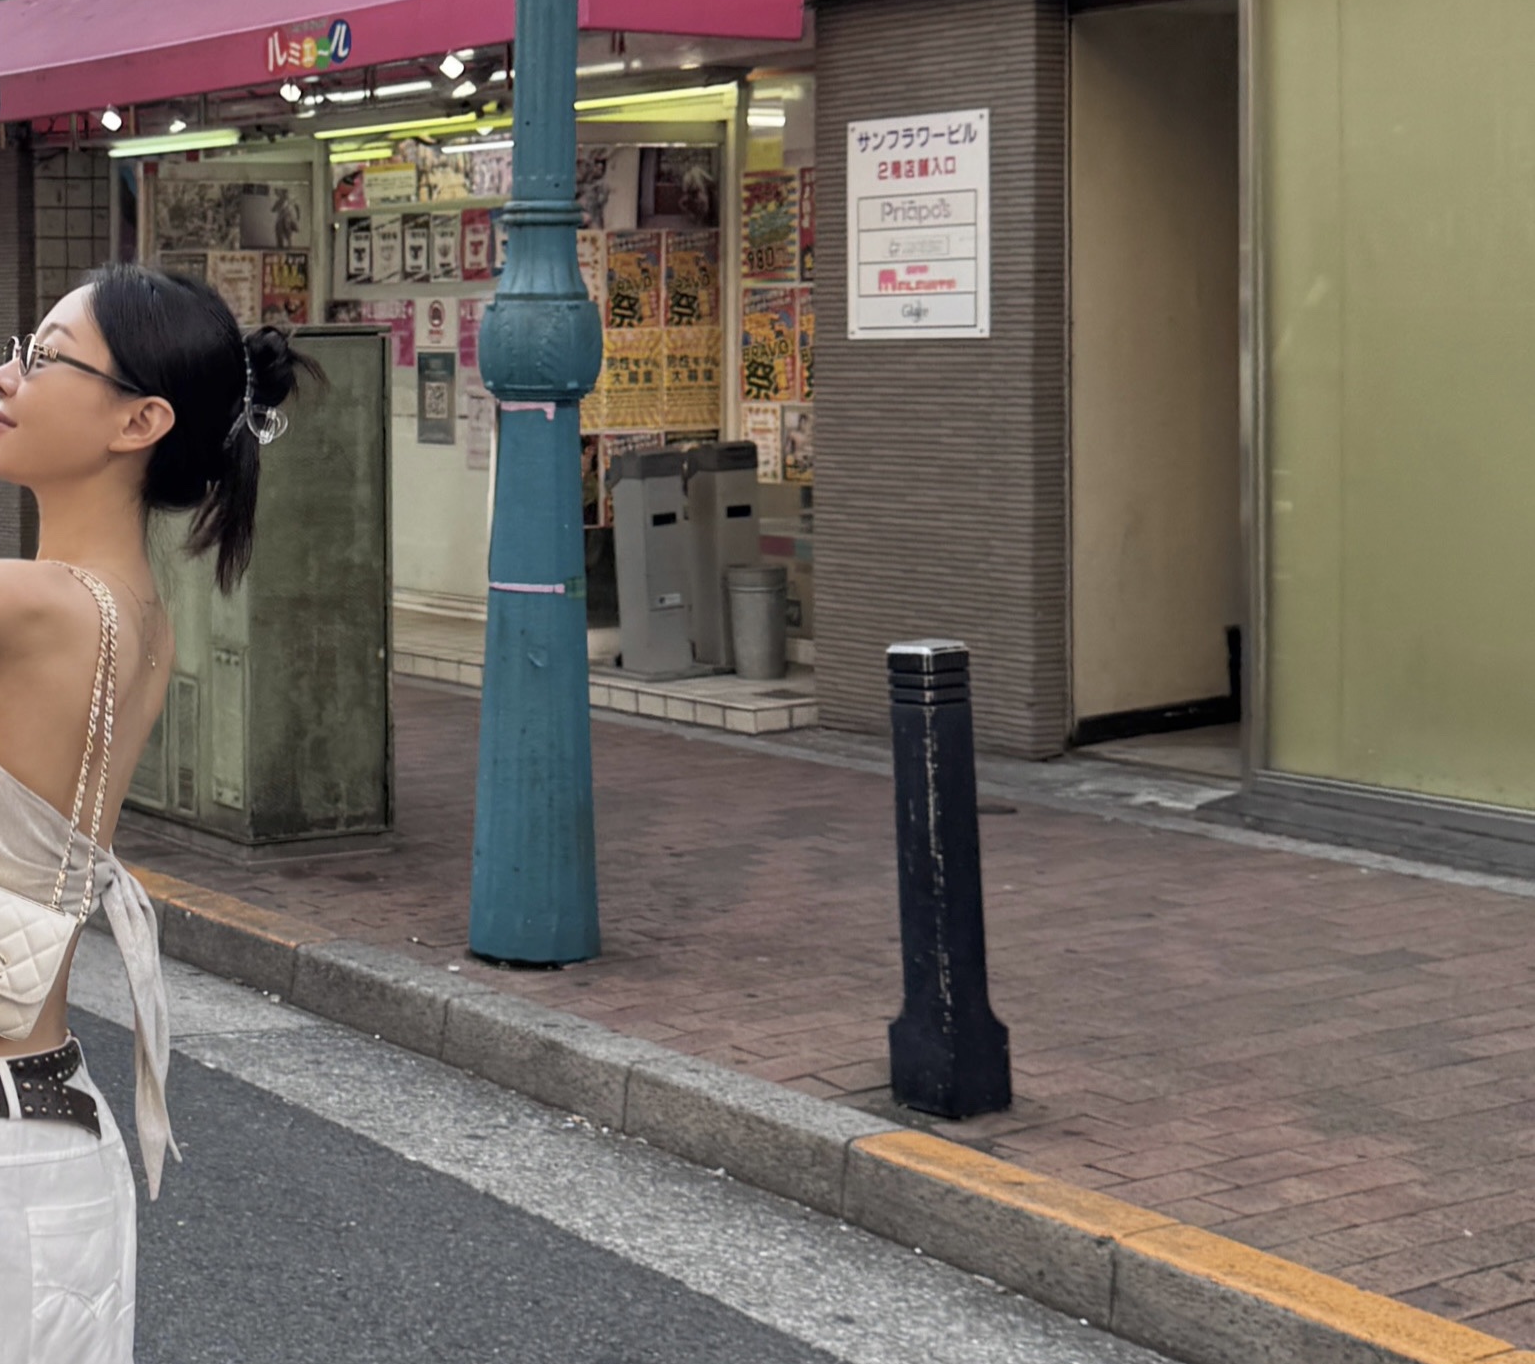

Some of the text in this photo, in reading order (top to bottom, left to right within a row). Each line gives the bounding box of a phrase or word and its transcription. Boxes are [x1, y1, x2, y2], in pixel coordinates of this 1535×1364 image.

[267, 23, 350, 72] ルミエール
[857, 122, 977, 153] サンフラワービル
